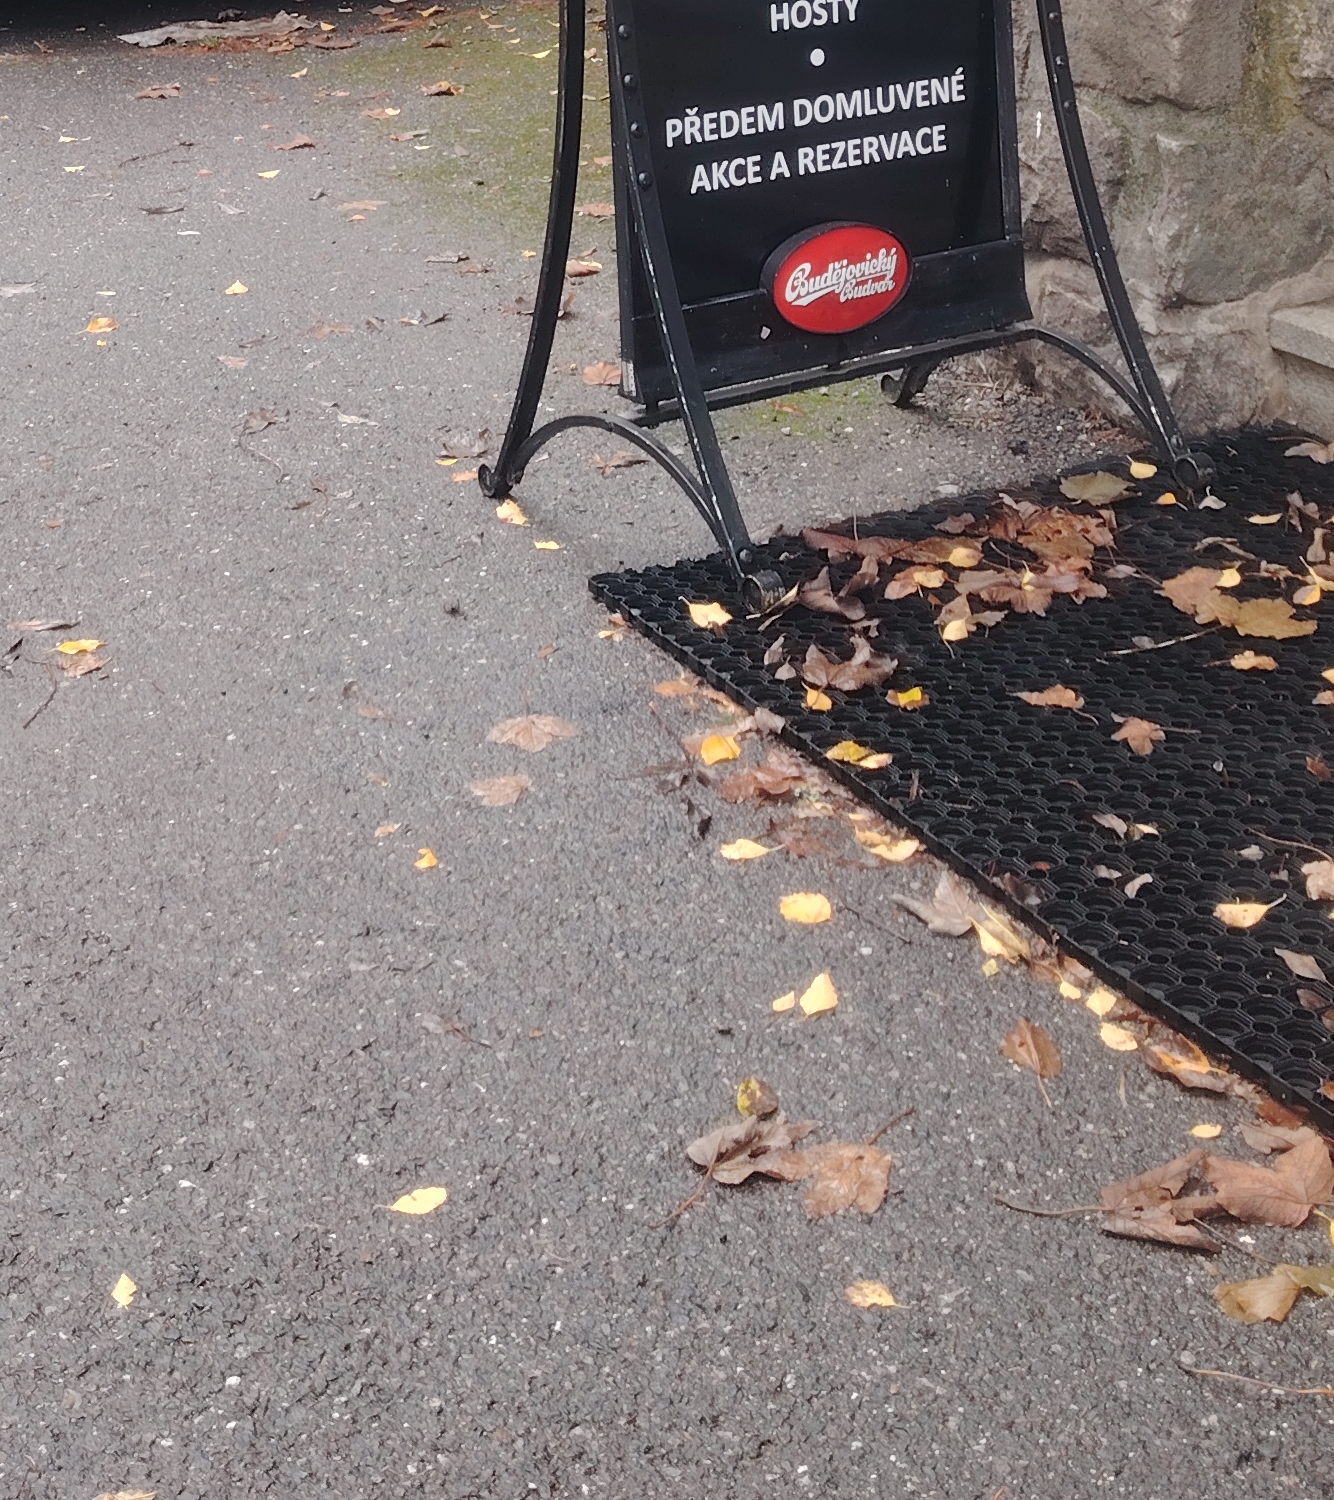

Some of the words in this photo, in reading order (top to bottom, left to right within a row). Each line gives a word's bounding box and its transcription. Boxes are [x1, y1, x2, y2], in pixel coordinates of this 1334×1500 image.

[665, 102, 785, 148] PŘEDEM
[793, 67, 967, 128] DOMLUVENÉ
[689, 155, 762, 194] AKCE
[769, 151, 791, 181] A
[797, 124, 948, 177] REZERVACE
[785, 247, 897, 306] Budějovický
[840, 279, 895, 303] Budvar
